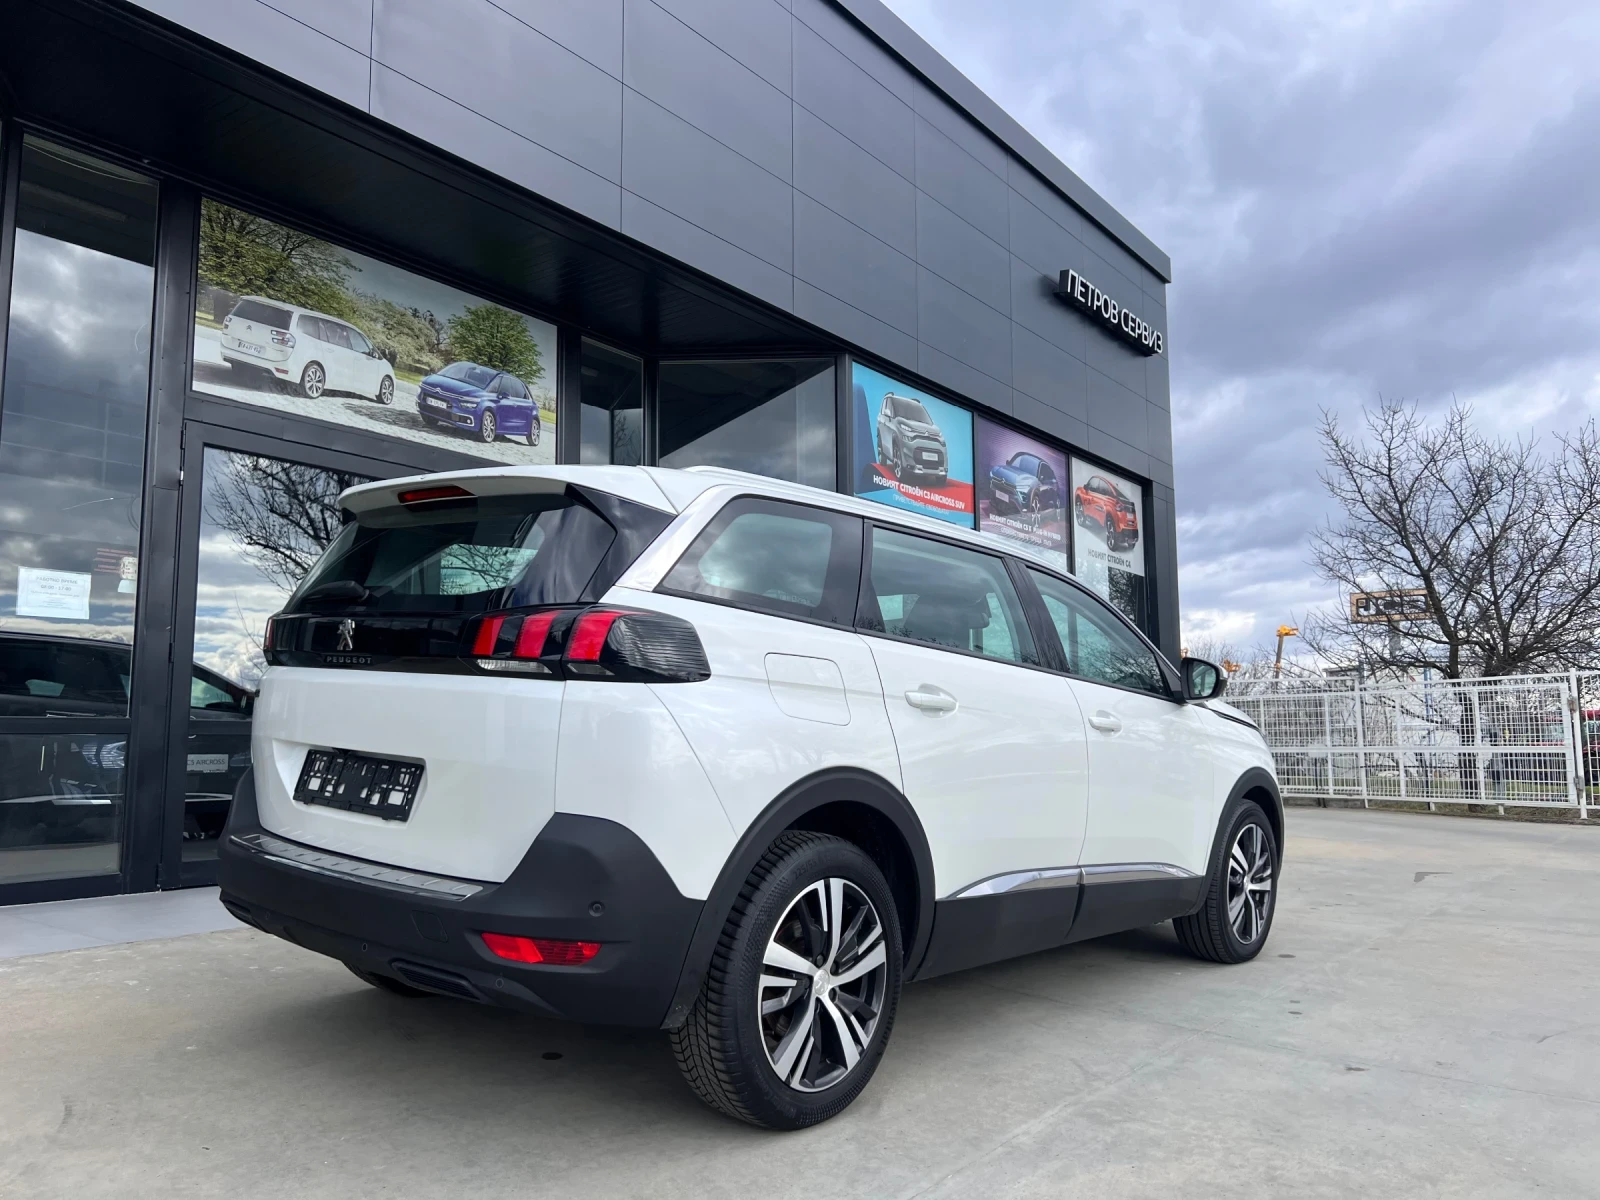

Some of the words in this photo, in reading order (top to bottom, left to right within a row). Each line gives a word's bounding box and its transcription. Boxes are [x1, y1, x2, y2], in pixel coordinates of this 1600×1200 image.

[1067, 268, 1119, 324] ПЕТРОВ
[1121, 308, 1163, 353] СЕРВИЗ
[873, 474, 899, 490] НОВИЯТ
[899, 483, 924, 498] CITROËN
[923, 490, 931, 500] C3
[930, 493, 955, 508] AIRCROSS
[954, 501, 965, 510] SUV
[1107, 554, 1125, 566] CITROËN
[326, 655, 372, 664] PEUGEOT
